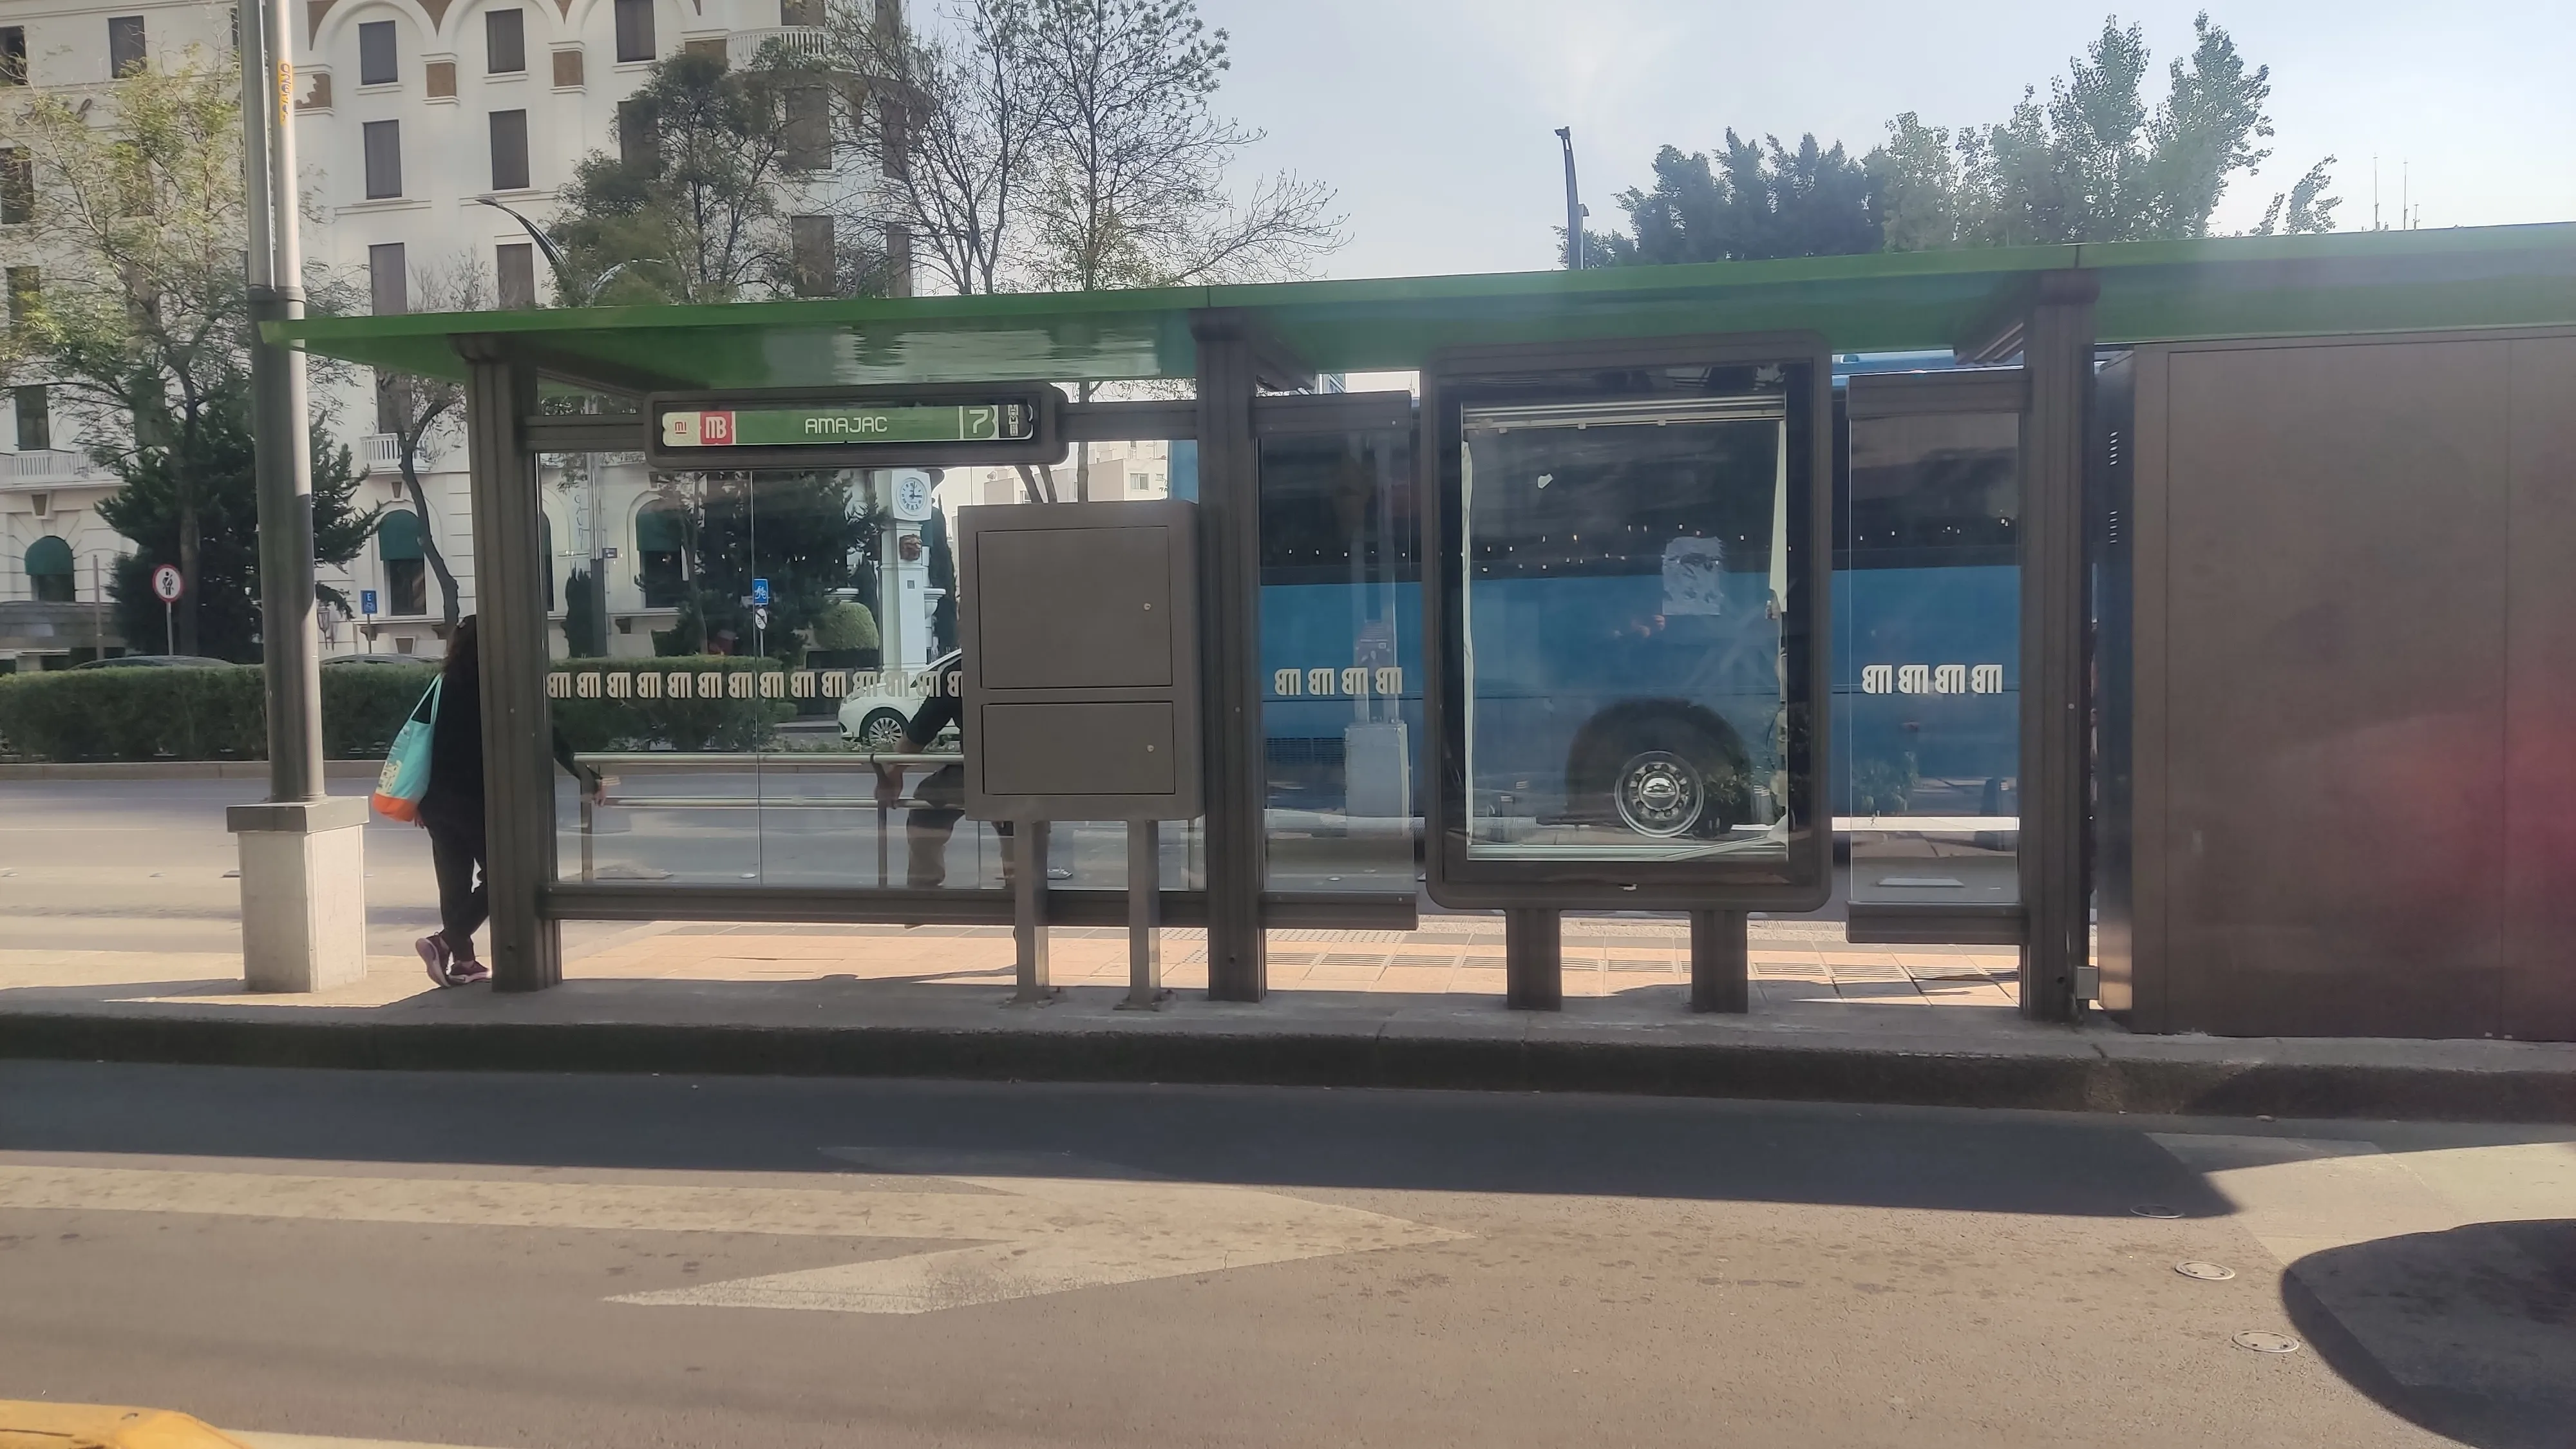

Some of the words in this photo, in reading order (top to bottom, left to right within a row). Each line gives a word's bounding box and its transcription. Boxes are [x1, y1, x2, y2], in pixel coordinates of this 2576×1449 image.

[804, 416, 888, 435] AMAJAC
[969, 409, 989, 434] 7
[367, 592, 372, 601] E
